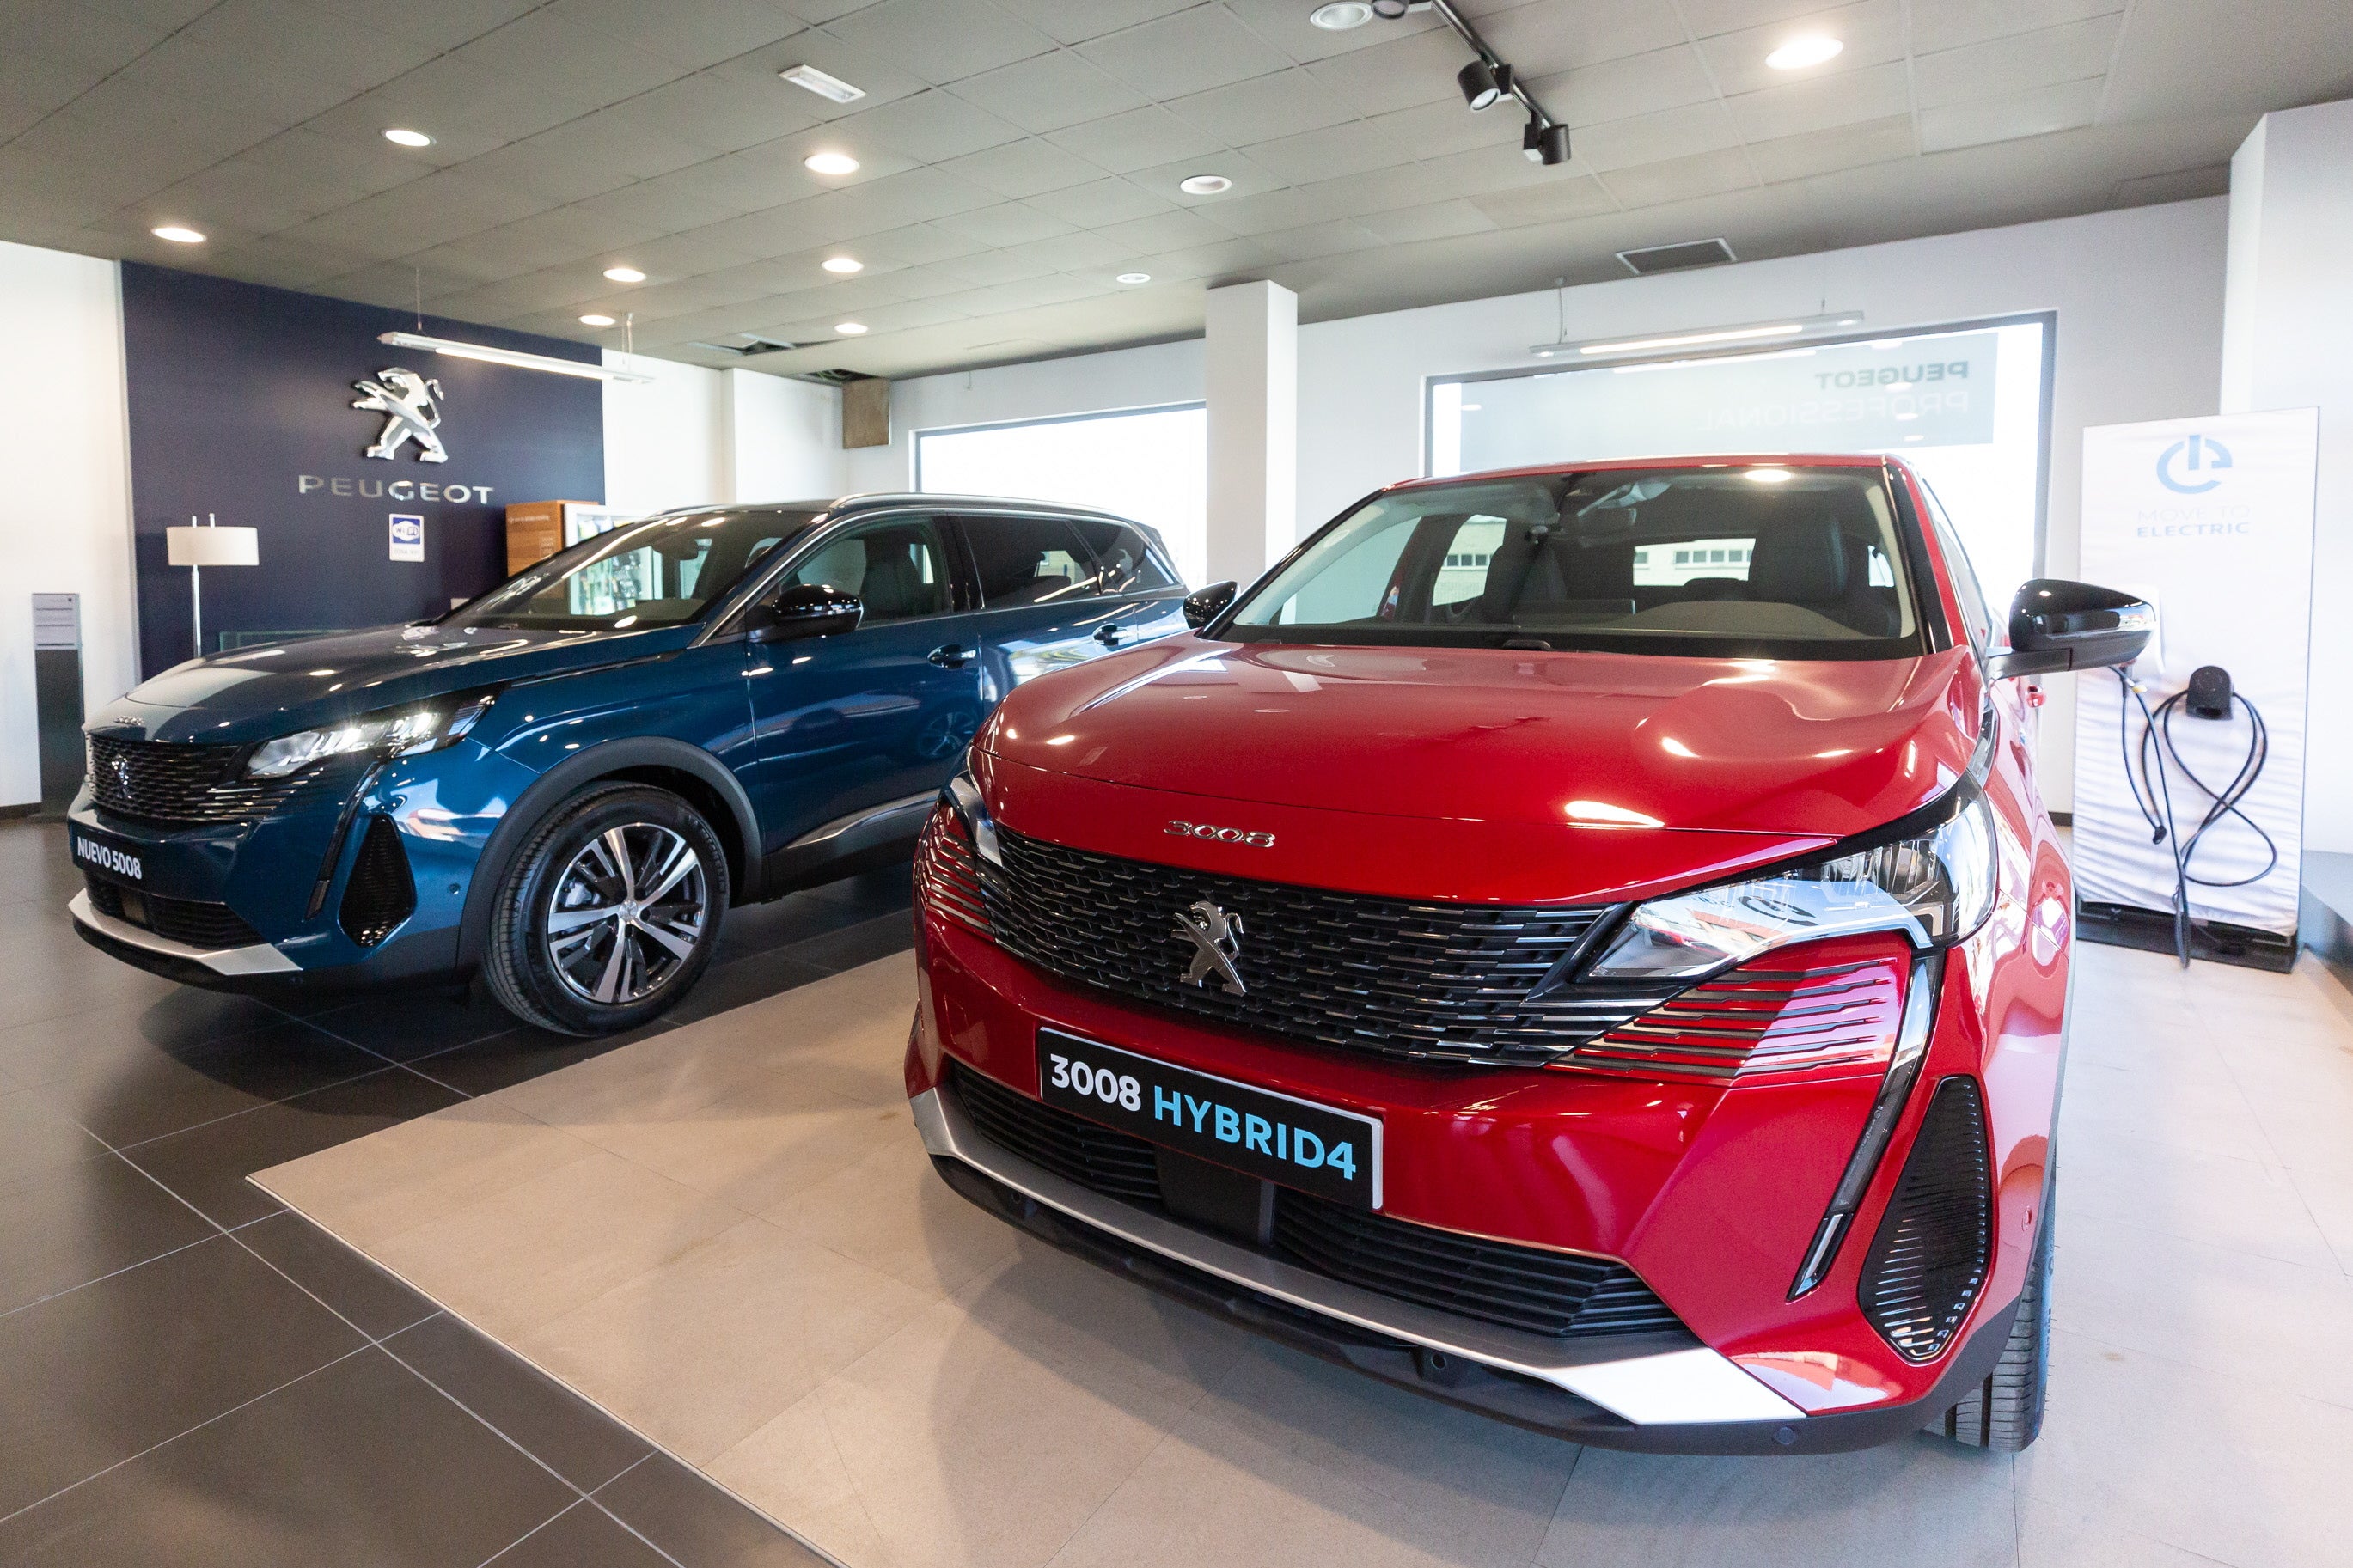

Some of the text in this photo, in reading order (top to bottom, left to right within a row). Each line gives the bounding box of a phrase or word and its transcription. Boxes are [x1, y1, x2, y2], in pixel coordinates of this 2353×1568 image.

[298, 474, 494, 504] PEUGEOT
[2136, 522, 2251, 538] ELECTRIC
[1163, 820, 1276, 848] 3008
[77, 836, 142, 880] NUEVO 5008
[1049, 1053, 1356, 1181] 3008 HYBRID4
